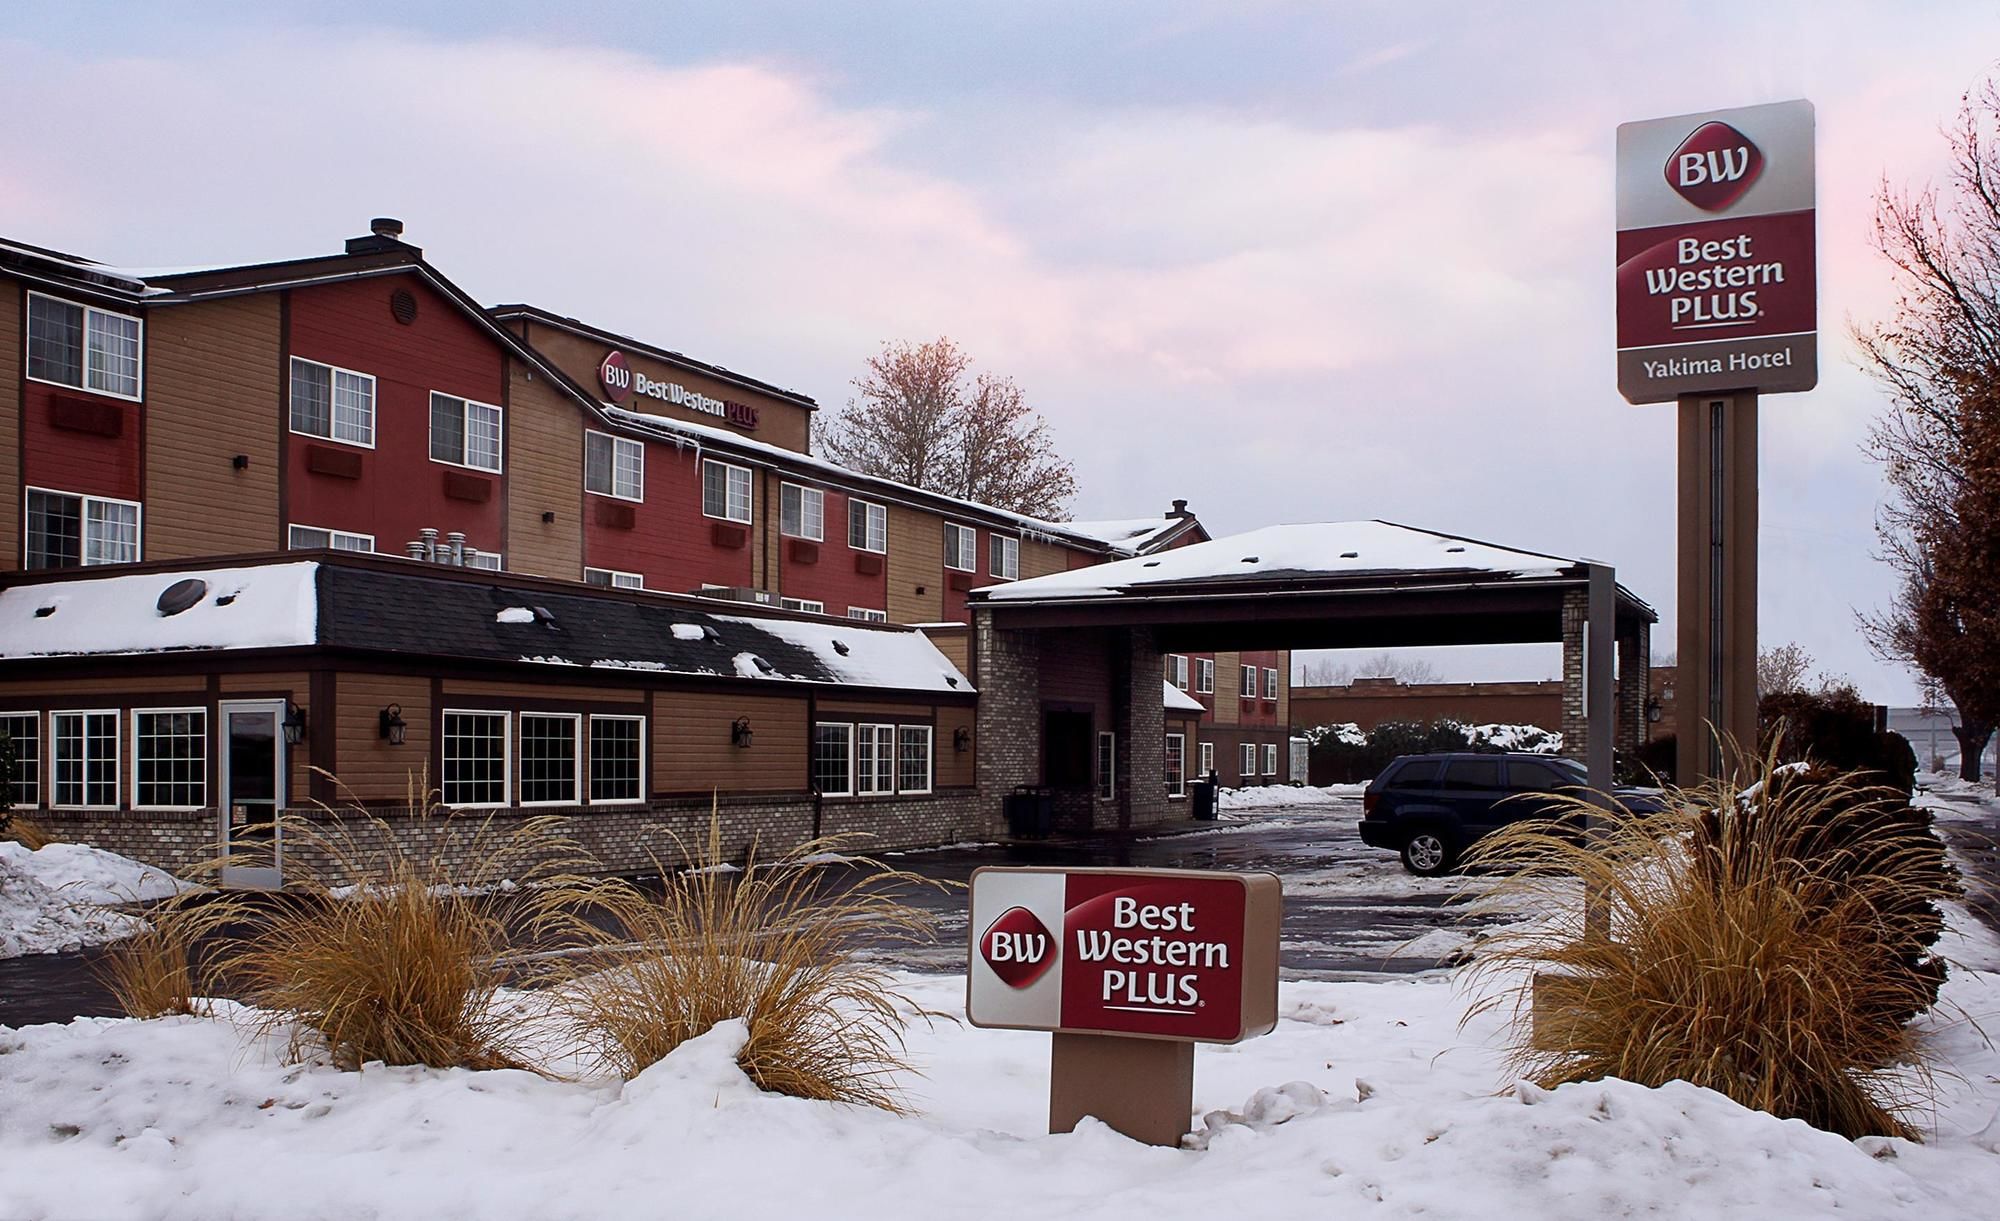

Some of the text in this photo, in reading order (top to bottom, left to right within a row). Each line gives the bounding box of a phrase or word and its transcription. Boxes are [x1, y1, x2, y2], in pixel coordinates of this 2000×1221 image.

[1679, 146, 1749, 187] BW
[1677, 235, 1753, 265] Best
[1646, 261, 1785, 295] Western
[605, 364, 630, 389] BW
[1644, 348, 1792, 379] Yakima Hotel
[634, 373, 760, 426] Best Western PLUS
[1114, 897, 1196, 932] Best
[991, 932, 1046, 964] BW
[1076, 930, 1230, 969] Western
